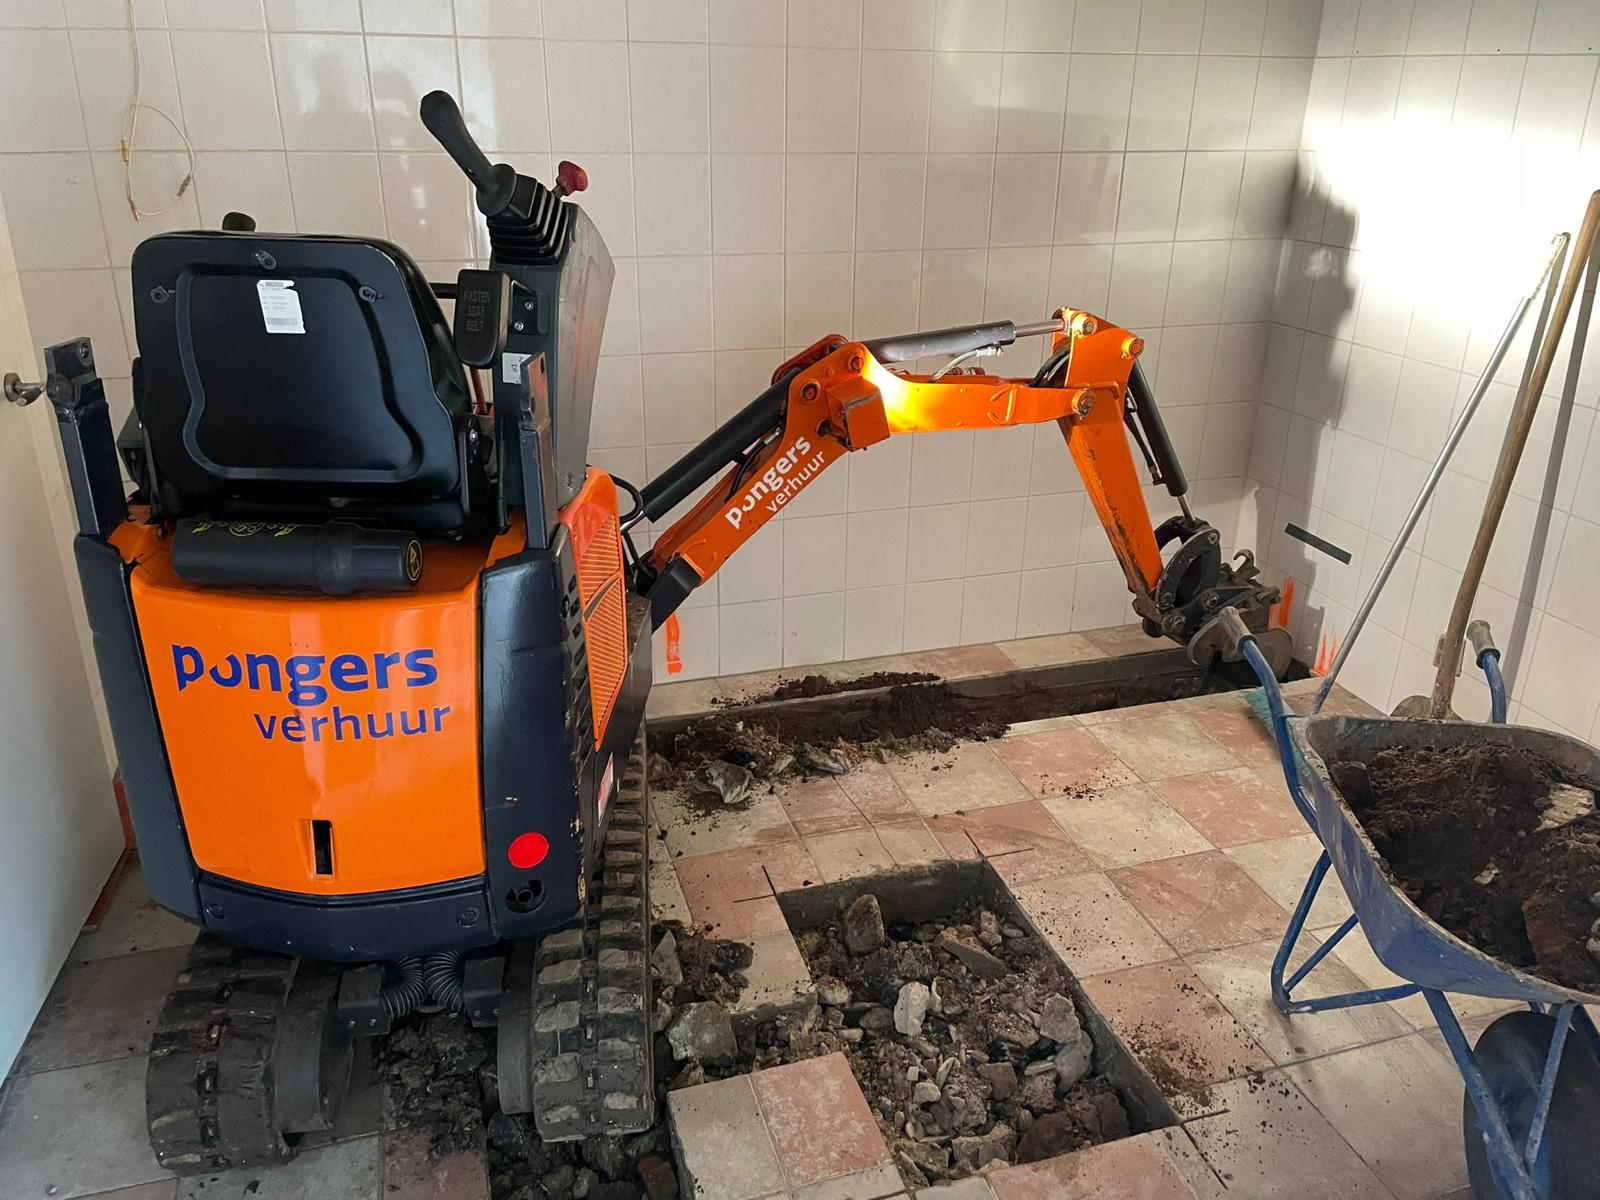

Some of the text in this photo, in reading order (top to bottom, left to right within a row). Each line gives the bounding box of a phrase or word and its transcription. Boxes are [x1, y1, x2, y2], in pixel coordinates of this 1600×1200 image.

[724, 436, 811, 530] pongers
[766, 451, 825, 512] verhuur
[171, 643, 438, 707] pongers
[253, 705, 451, 742] verhuur
